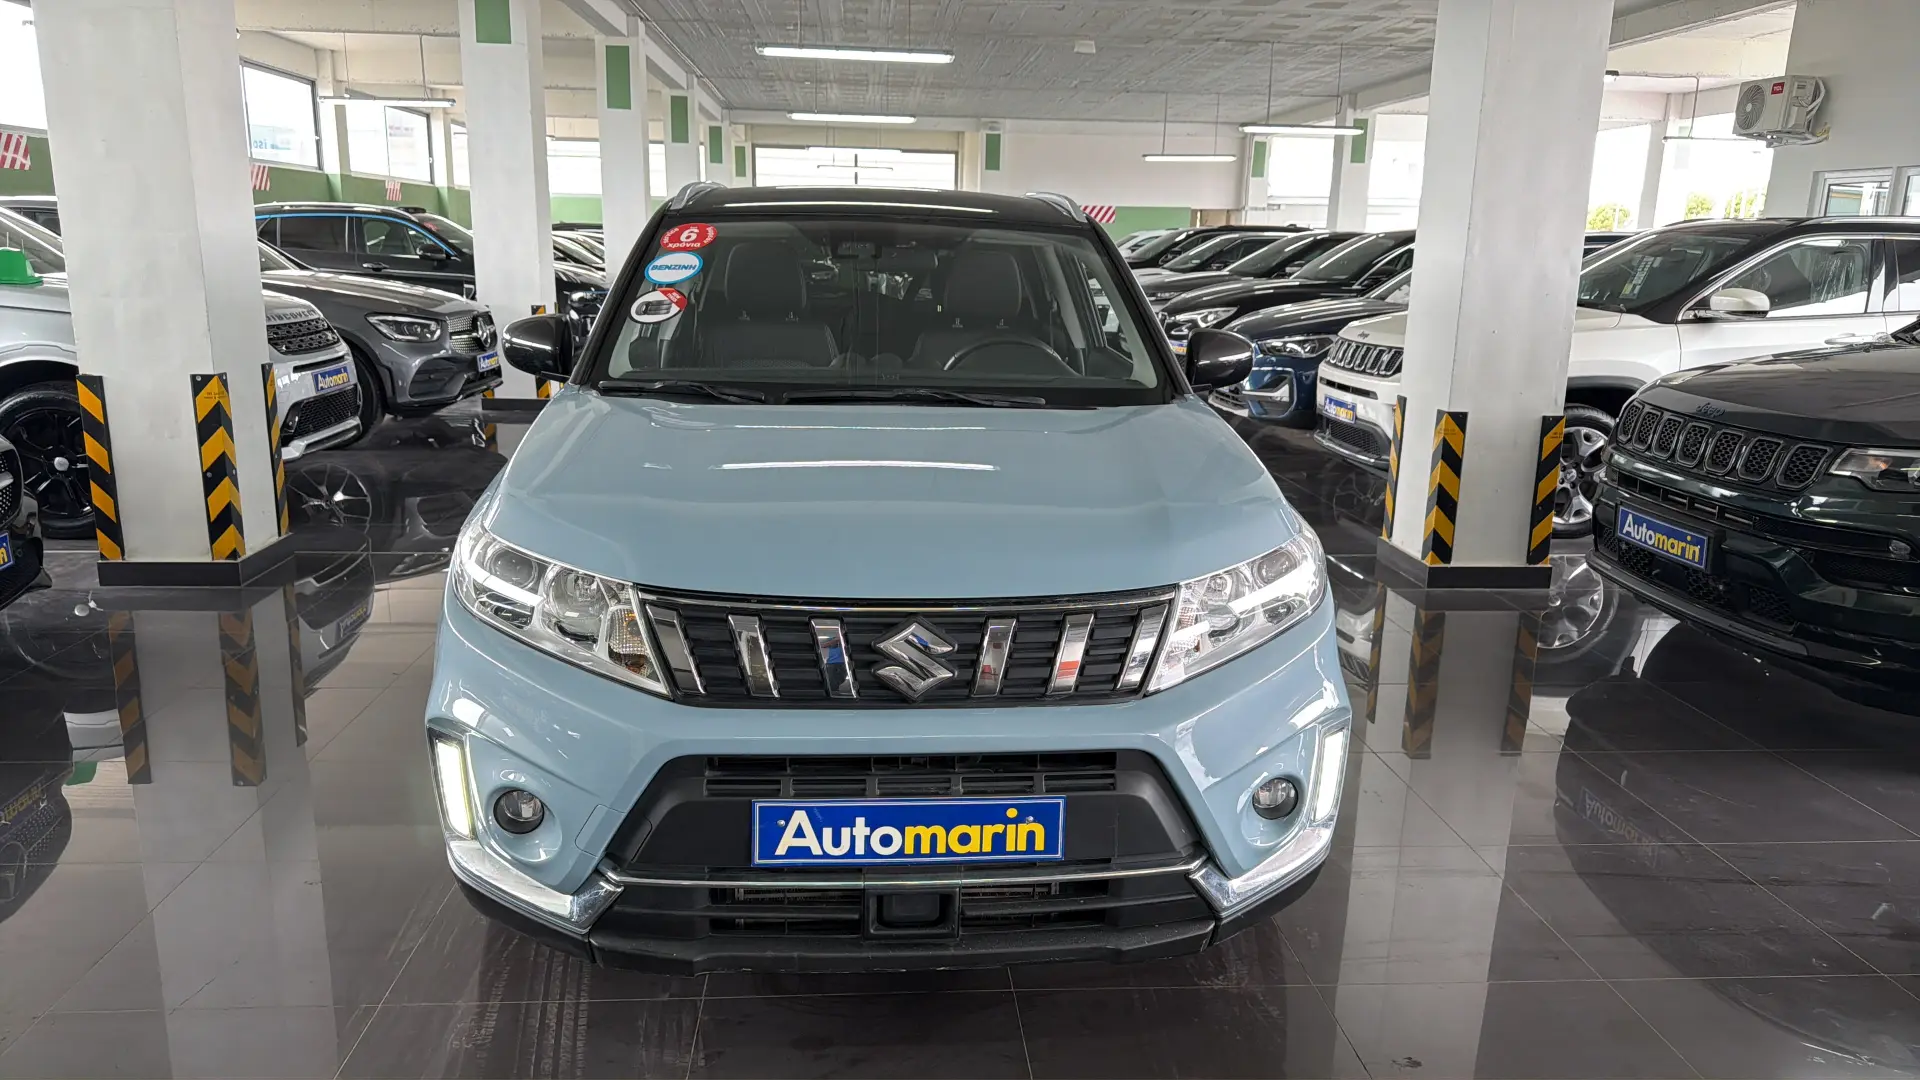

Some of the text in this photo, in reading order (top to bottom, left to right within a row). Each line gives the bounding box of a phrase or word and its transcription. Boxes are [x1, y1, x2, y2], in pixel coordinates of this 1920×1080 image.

[667, 241, 701, 249] χρόνια
[679, 228, 700, 242] 6
[318, 368, 349, 391] Automarin
[1324, 398, 1354, 421] Automarin
[1695, 402, 1726, 418] Jeep
[1622, 513, 1700, 563] Automarin
[774, 807, 1045, 856] Automarin
